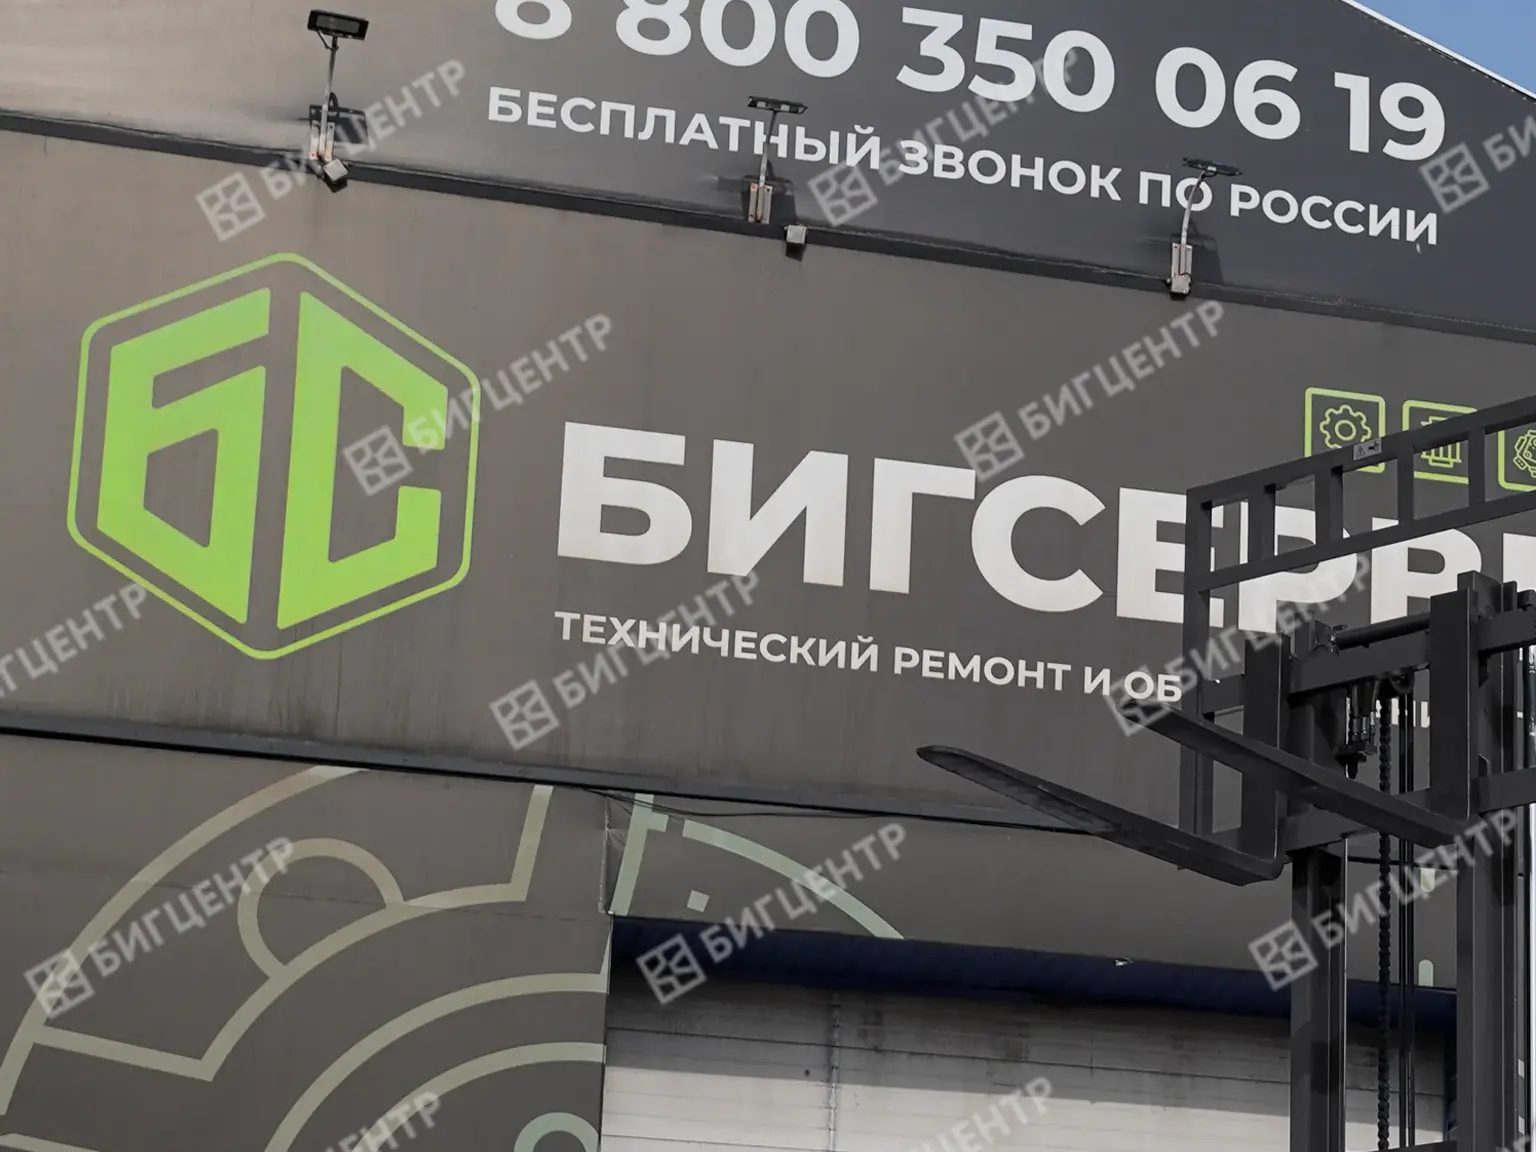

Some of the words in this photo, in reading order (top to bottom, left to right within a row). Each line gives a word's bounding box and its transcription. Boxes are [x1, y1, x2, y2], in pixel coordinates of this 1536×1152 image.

[615, 0, 860, 78] 800
[895, 6, 1115, 113] 350
[1154, 46, 1301, 140] 06
[1333, 70, 1446, 161] 19
[486, 85, 882, 170] БЕСПЛАТНЫЙ
[897, 138, 1122, 203] ЗВОНОК
[1138, 169, 1212, 212] ПО
[1229, 181, 1439, 246] РОССИИ
[554, 610, 879, 672] ТЕХНИЧЕСКИЙ
[893, 645, 1072, 692] РЕМОНТ
[1083, 667, 1111, 696] И
